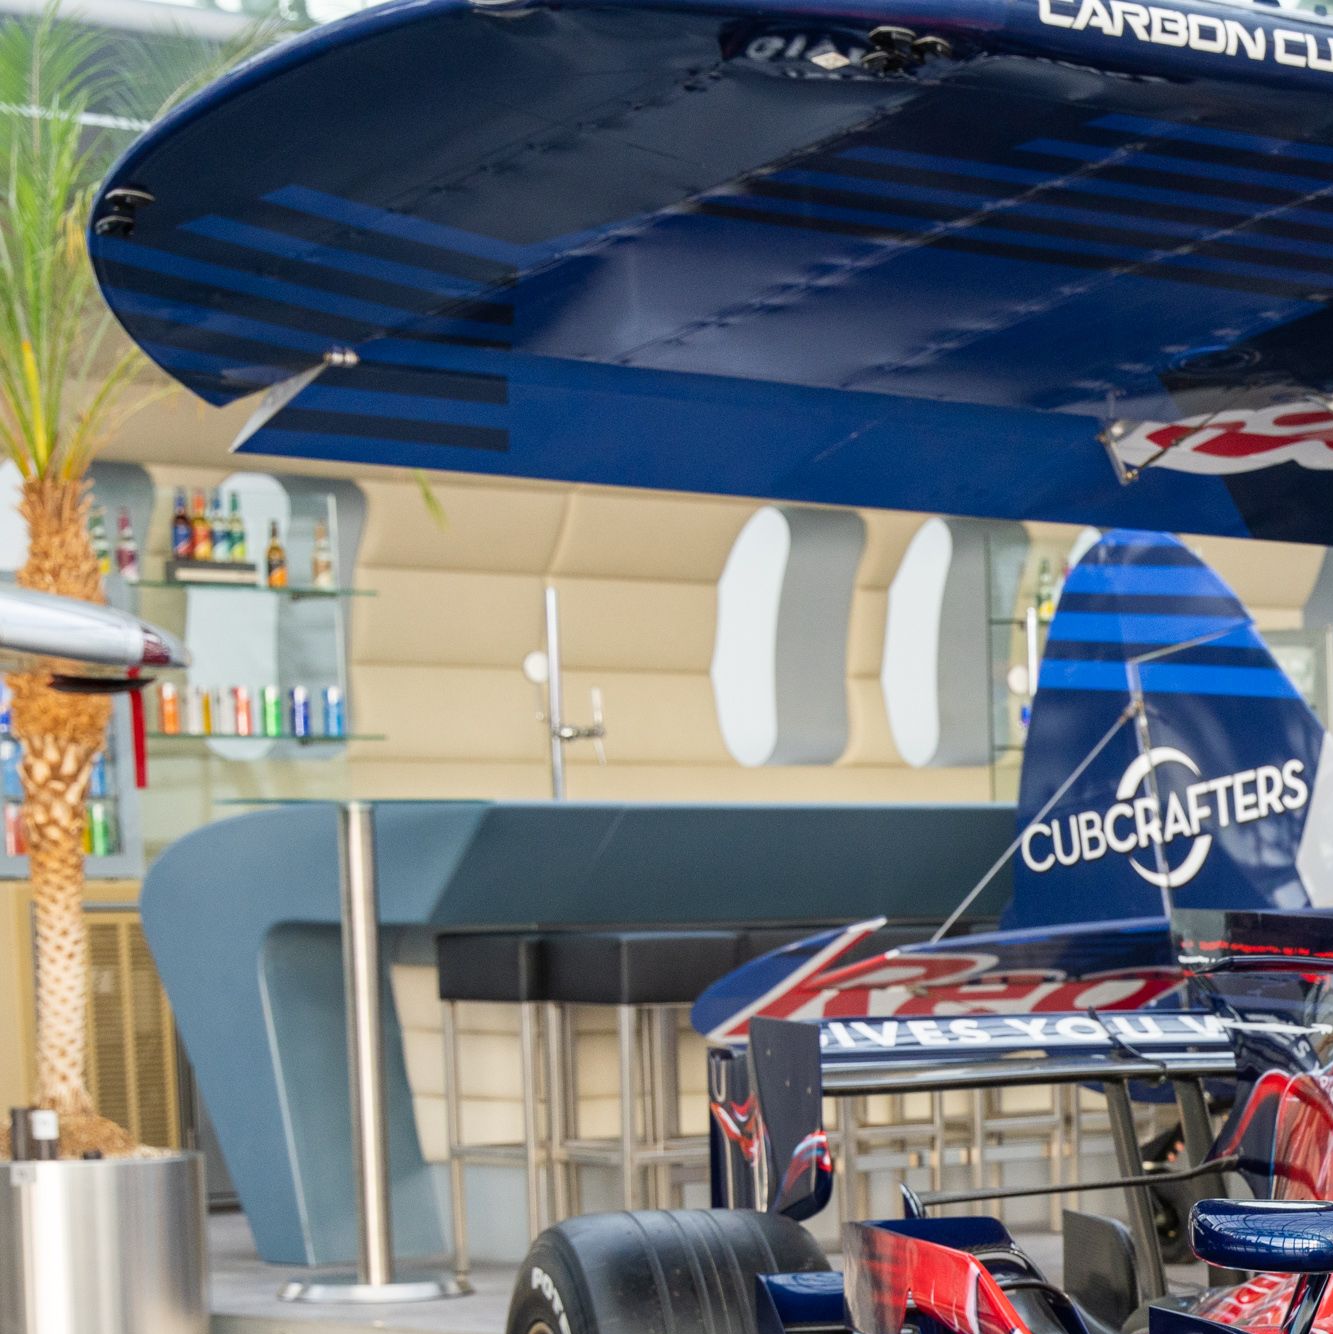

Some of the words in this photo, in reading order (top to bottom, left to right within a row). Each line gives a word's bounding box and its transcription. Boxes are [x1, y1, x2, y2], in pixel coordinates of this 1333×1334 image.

[1039, 0, 1266, 61] CARBON
[1021, 759, 1309, 873] CUBCRAFTERS
[820, 1018, 992, 1048] IVES
[1005, 1013, 1164, 1044] YOU
